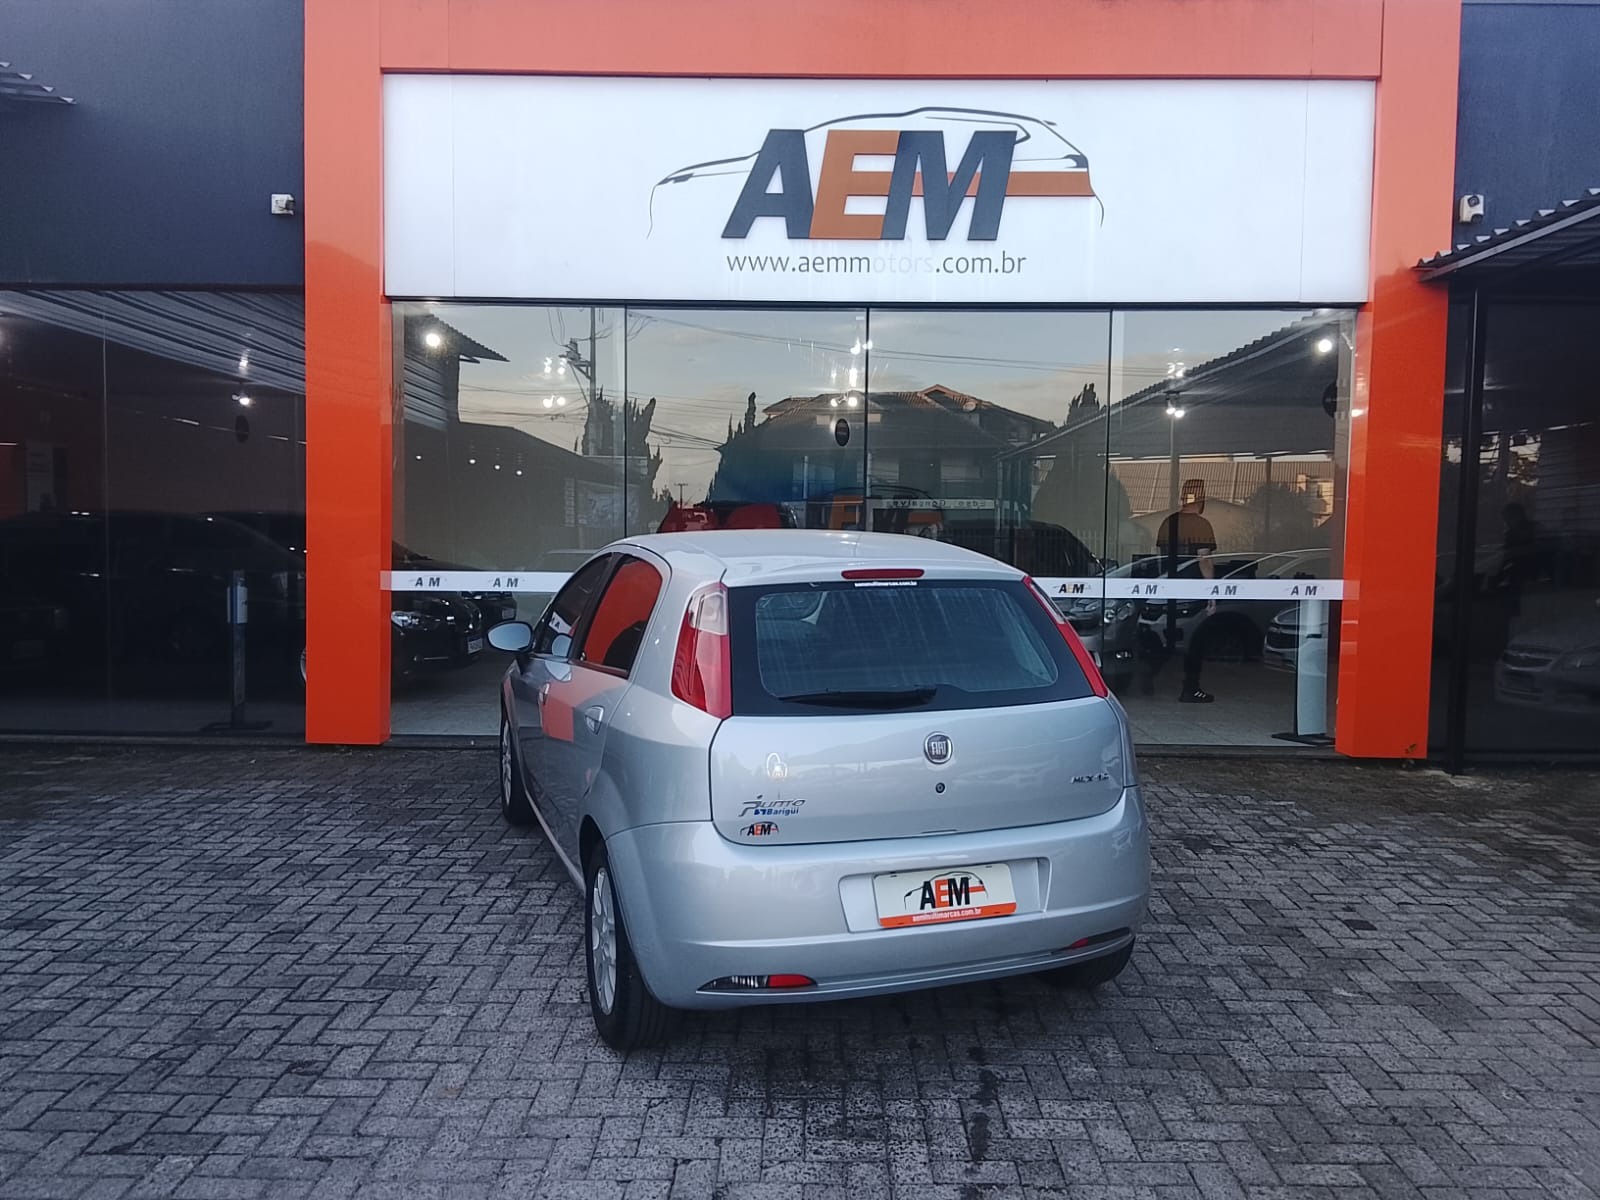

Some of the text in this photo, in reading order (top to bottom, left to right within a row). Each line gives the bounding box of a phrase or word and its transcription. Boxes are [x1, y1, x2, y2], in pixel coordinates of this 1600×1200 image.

[721, 129, 1018, 241] AEM
[746, 823, 771, 837] AEM
[919, 876, 971, 911] AEM
